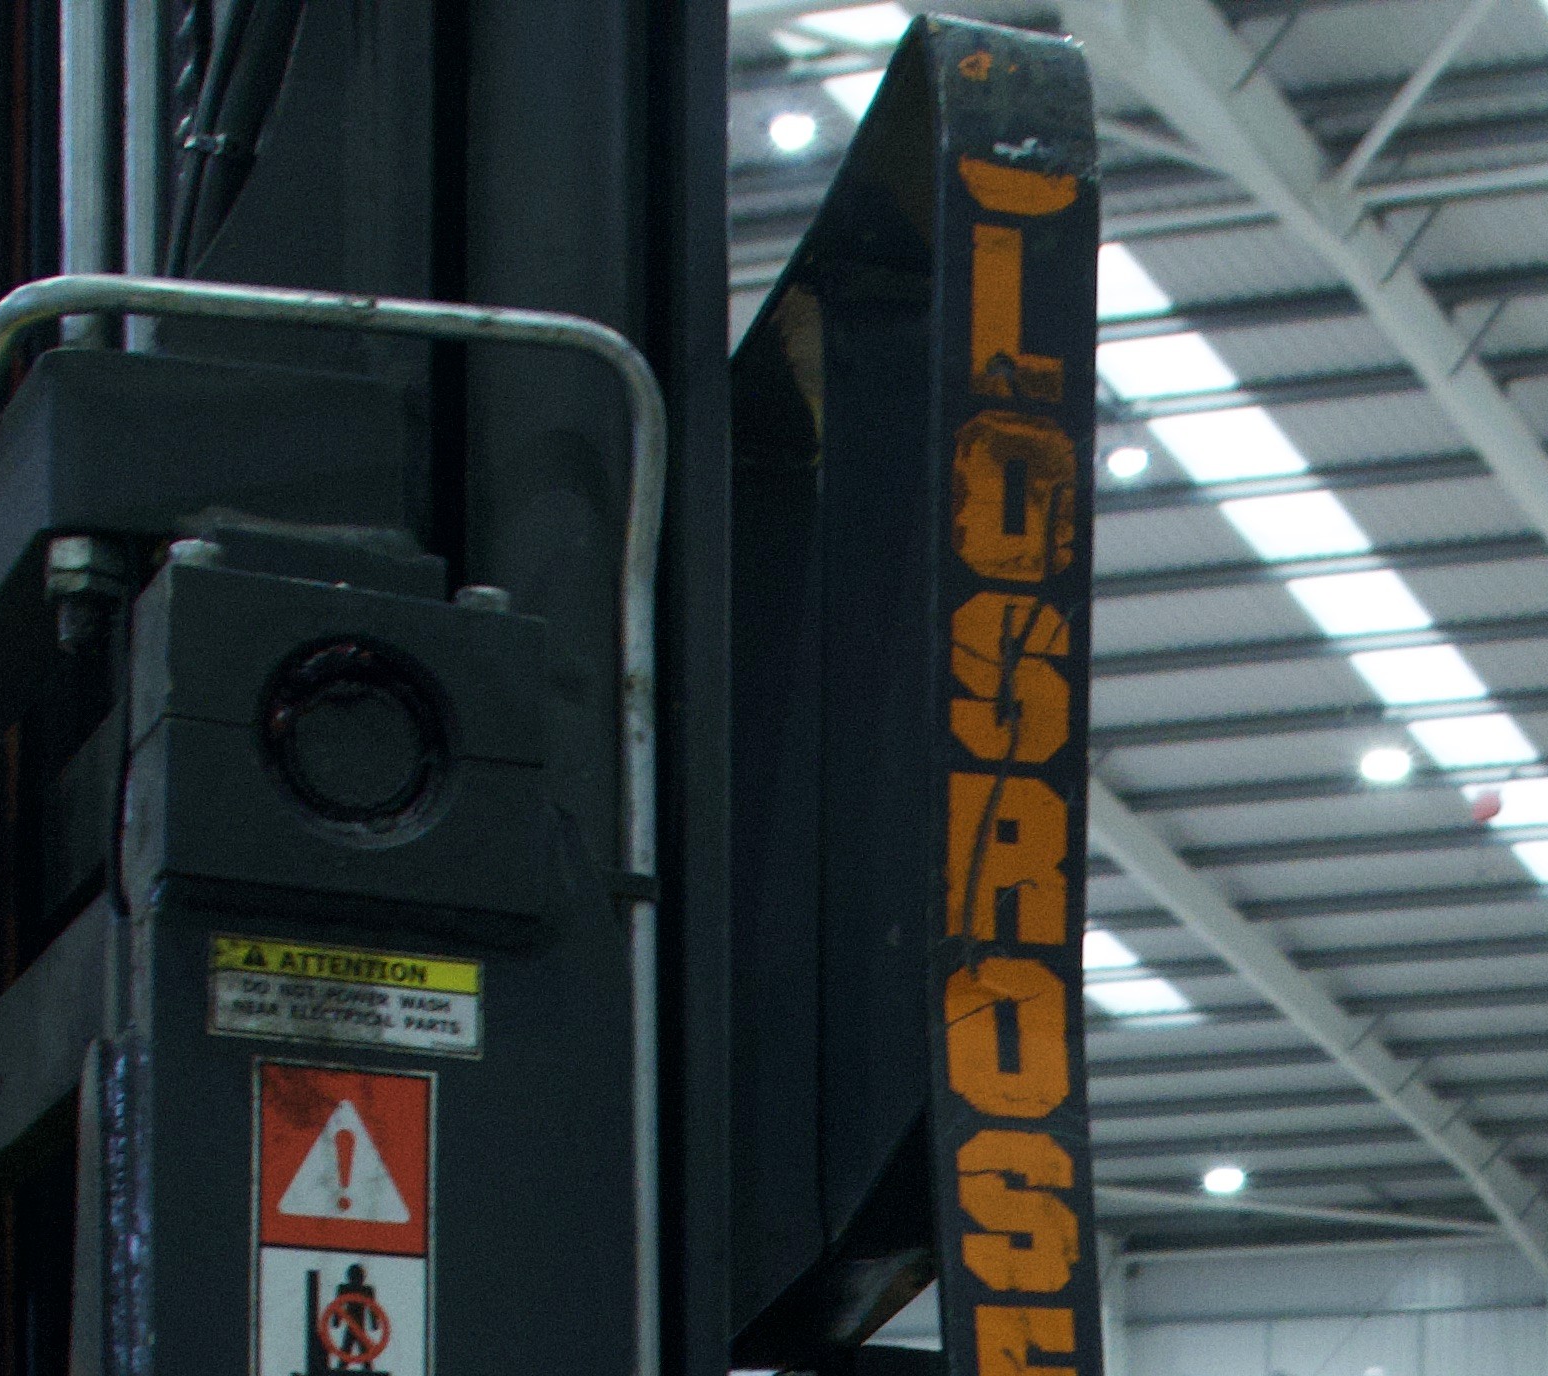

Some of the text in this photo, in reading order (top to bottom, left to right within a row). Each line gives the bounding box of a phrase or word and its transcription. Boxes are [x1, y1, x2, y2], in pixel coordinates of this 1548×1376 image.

[279, 951, 428, 984] ATTENTION
[398, 994, 452, 1013] WASH
[404, 1015, 462, 1036] PARTS
